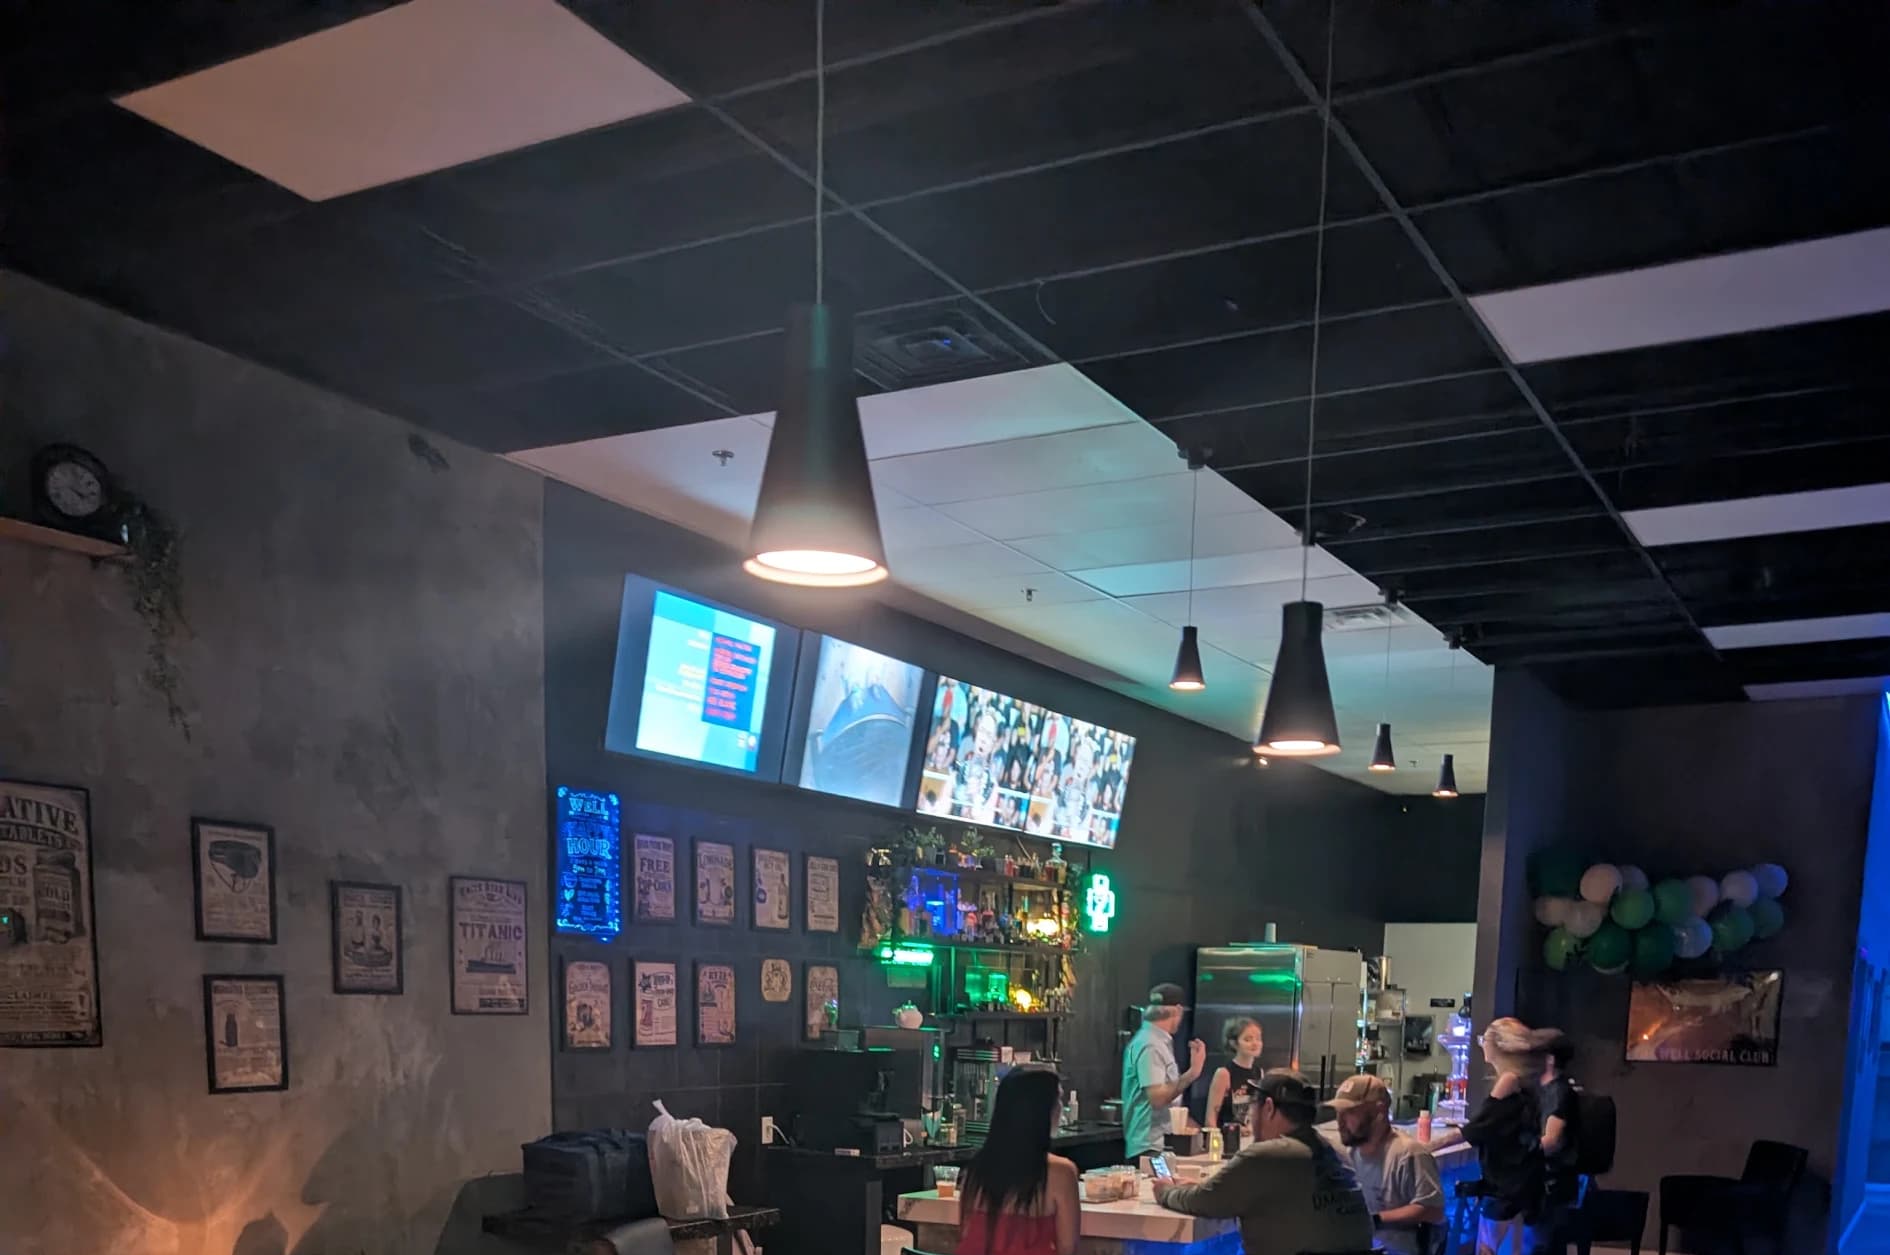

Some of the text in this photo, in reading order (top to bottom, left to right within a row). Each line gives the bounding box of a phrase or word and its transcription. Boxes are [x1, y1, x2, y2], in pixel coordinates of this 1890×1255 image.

[568, 798, 608, 815] WELL
[566, 838, 611, 859] HOUR
[640, 857, 671, 873] FREE
[459, 922, 522, 940] TITANIC
[1695, 1047, 1735, 1062] SOCIAL
